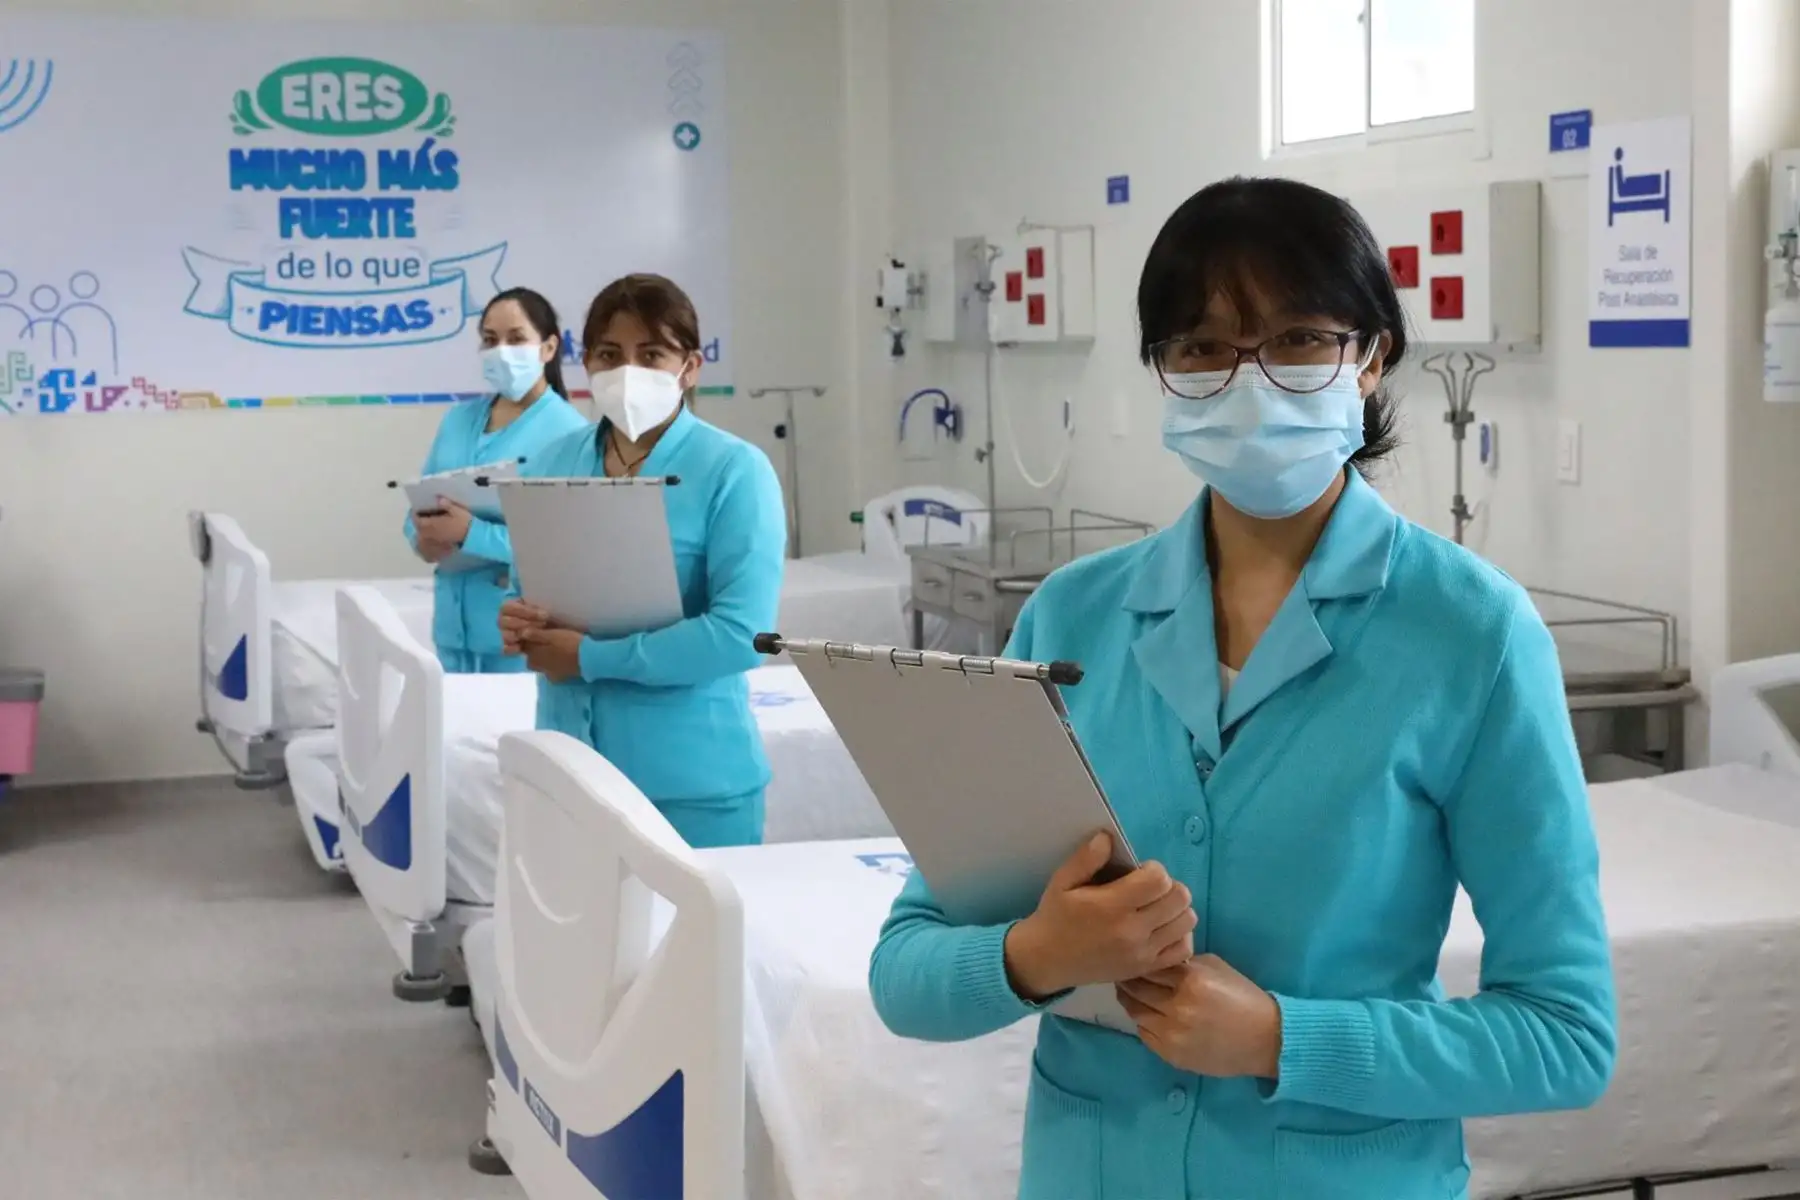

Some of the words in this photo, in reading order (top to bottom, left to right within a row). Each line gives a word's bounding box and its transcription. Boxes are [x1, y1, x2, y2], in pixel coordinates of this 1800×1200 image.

[280, 71, 406, 123] ERES
[229, 148, 366, 192] MUCHO
[378, 137, 460, 192] MÁS
[279, 197, 416, 239] FUERTE
[277, 252, 315, 279] de
[326, 252, 353, 279] lo
[363, 256, 421, 286] que
[258, 299, 434, 336] PIENSAS
